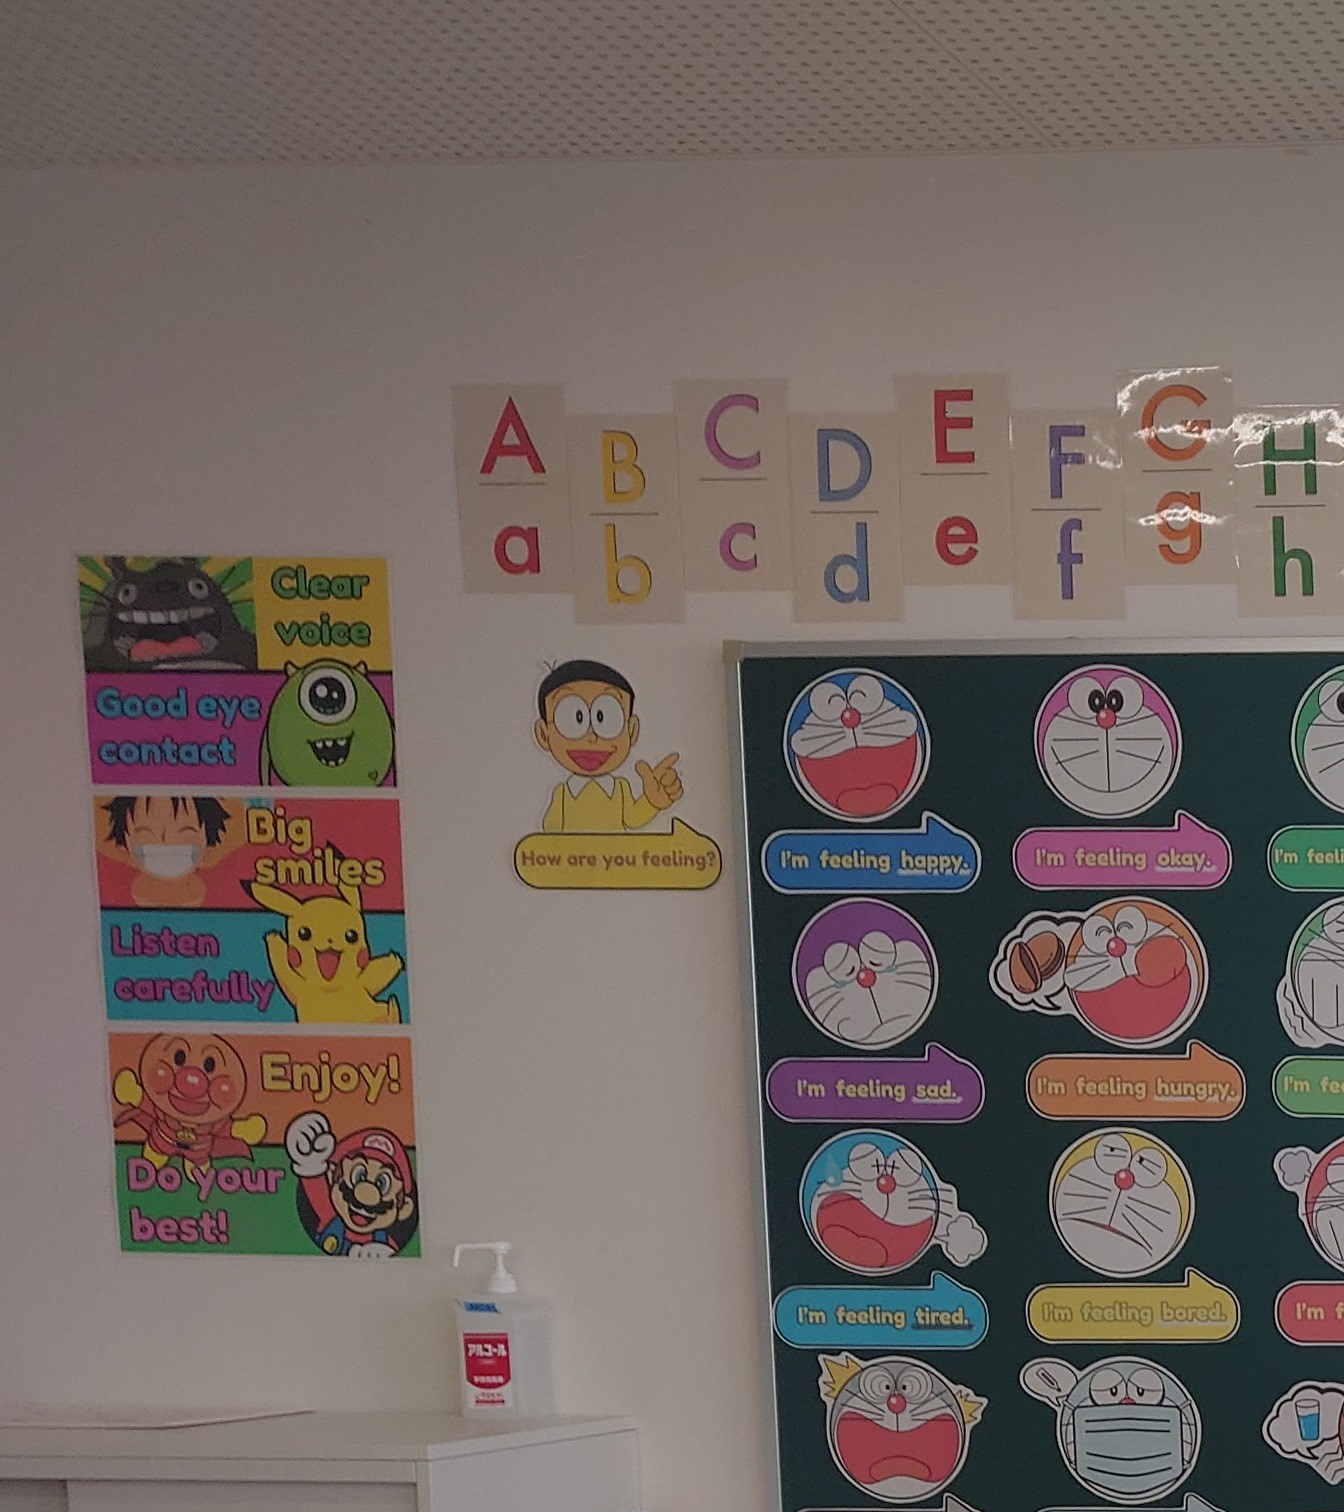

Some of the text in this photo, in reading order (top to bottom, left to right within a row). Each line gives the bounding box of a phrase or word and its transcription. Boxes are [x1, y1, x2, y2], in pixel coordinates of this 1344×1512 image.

[479, 397, 546, 474] A
[705, 394, 761, 469] C
[934, 389, 974, 463] E
[1141, 384, 1210, 461] G
[602, 430, 645, 502] B
[816, 429, 872, 501] D
[1049, 425, 1085, 498] F
[1263, 424, 1317, 496] H
[494, 525, 540, 574] a
[935, 516, 978, 565] e
[1057, 519, 1083, 599] f
[1273, 516, 1313, 597] h
[604, 524, 651, 603] b
[824, 522, 870, 602] d
[271, 566, 369, 600] Clear
[275, 616, 371, 646] voice
[97, 686, 261, 727] Good eye
[100, 738, 236, 766] contact
[248, 808, 312, 851] Big
[255, 858, 385, 887] smiles
[521, 848, 716, 874] How are you feeling?
[781, 850, 969, 874] I'm feeling happy.
[1036, 848, 1213, 872] I'm feeling okay.
[1274, 848, 1300, 866] I'm
[110, 925, 219, 958] Listen
[115, 972, 274, 1012] carefully
[260, 1052, 401, 1103] Enjoy!
[796, 1079, 959, 1104] I'm feeling sad.
[1036, 1077, 1237, 1102] I'm feeling hungry.
[1282, 1076, 1311, 1094] I'm
[127, 1159, 284, 1200] Do your
[131, 1208, 228, 1243] best!
[796, 1306, 969, 1330] I'm feeling tired.
[1042, 1303, 1226, 1327] I'm feeling bored.
[1296, 1303, 1328, 1321] I'm
[467, 1343, 507, 1357] アルコール
